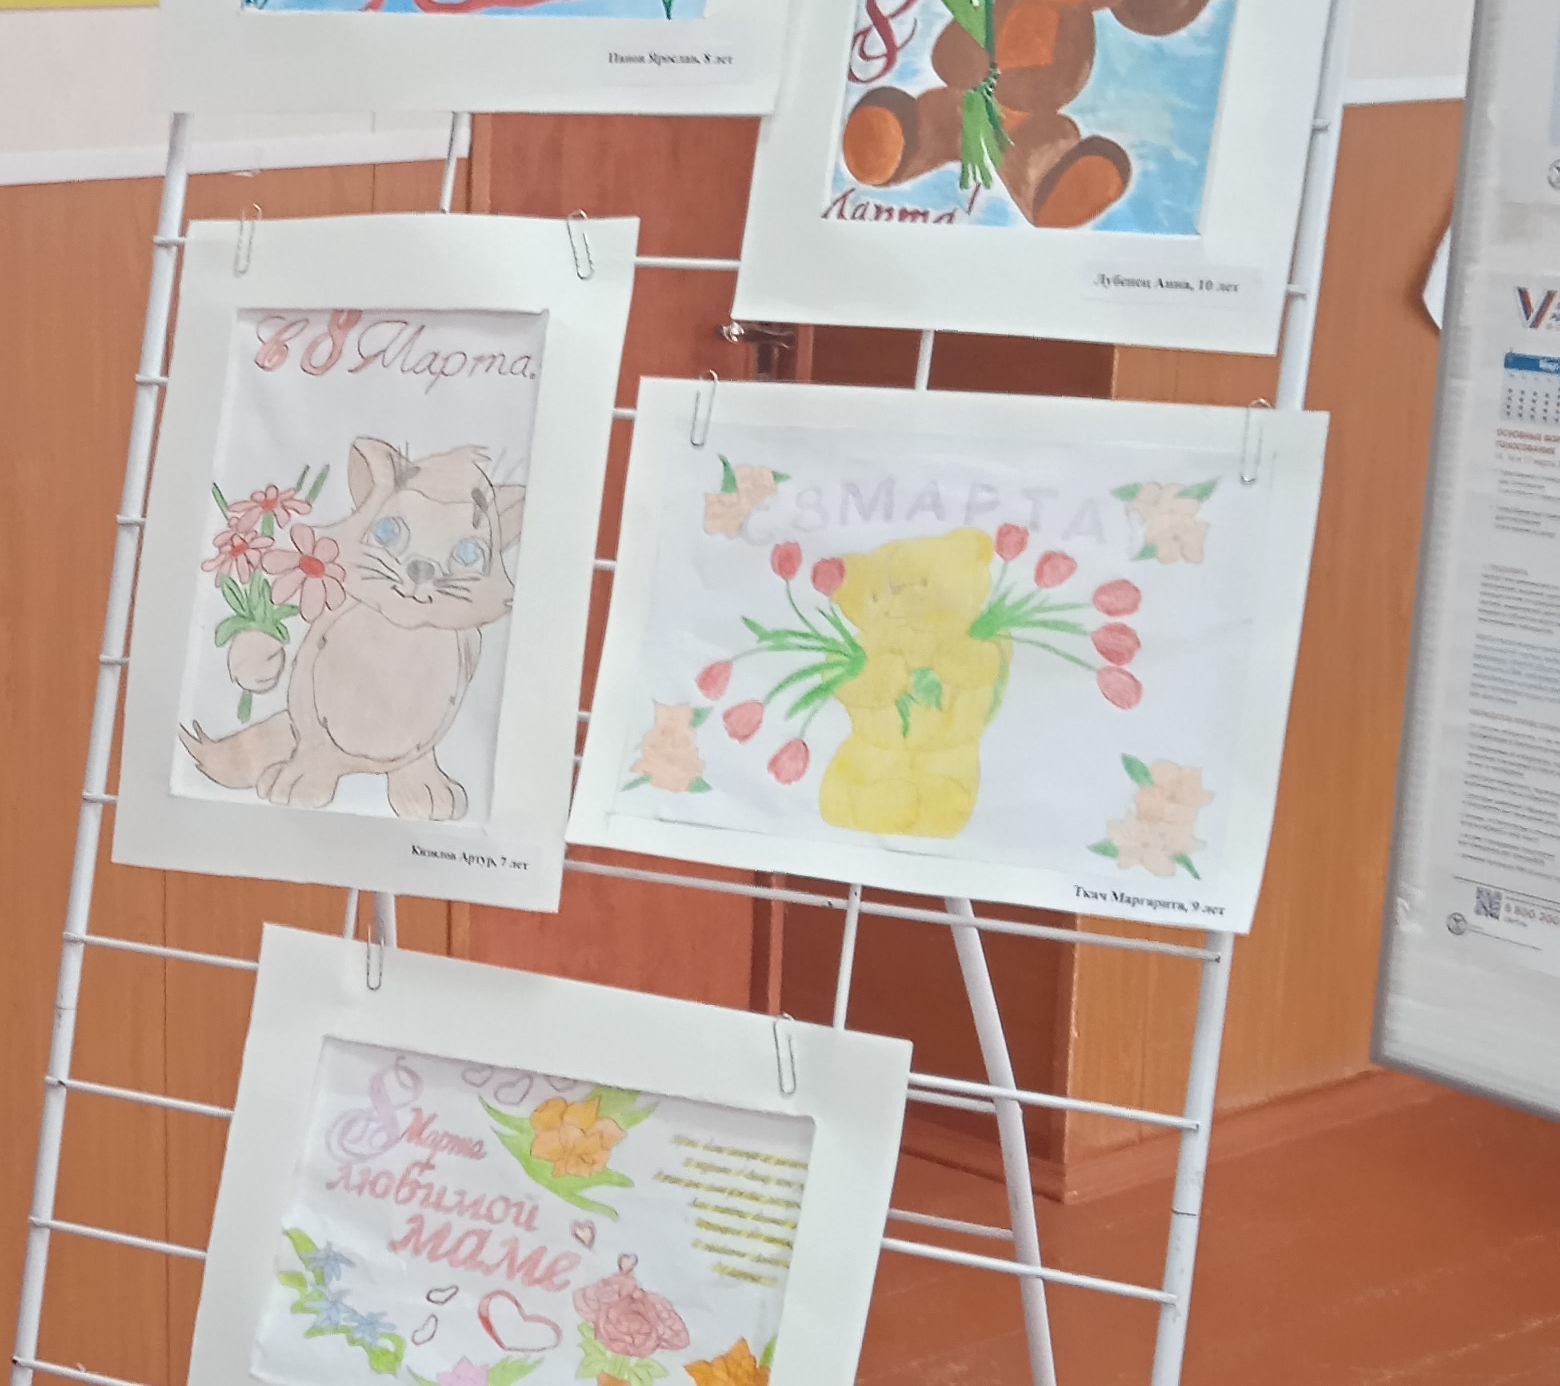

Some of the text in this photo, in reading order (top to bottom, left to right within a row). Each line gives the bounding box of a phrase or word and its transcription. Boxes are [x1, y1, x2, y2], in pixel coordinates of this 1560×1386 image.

[1198, 279, 1213, 291] 10
[1217, 282, 1239, 292] лет
[838, 476, 1108, 545] МАРТА
[509, 860, 528, 871] лет
[1074, 884, 1226, 916] Ткач Маргарита, 9 лет
[388, 1213, 582, 1293] маме
